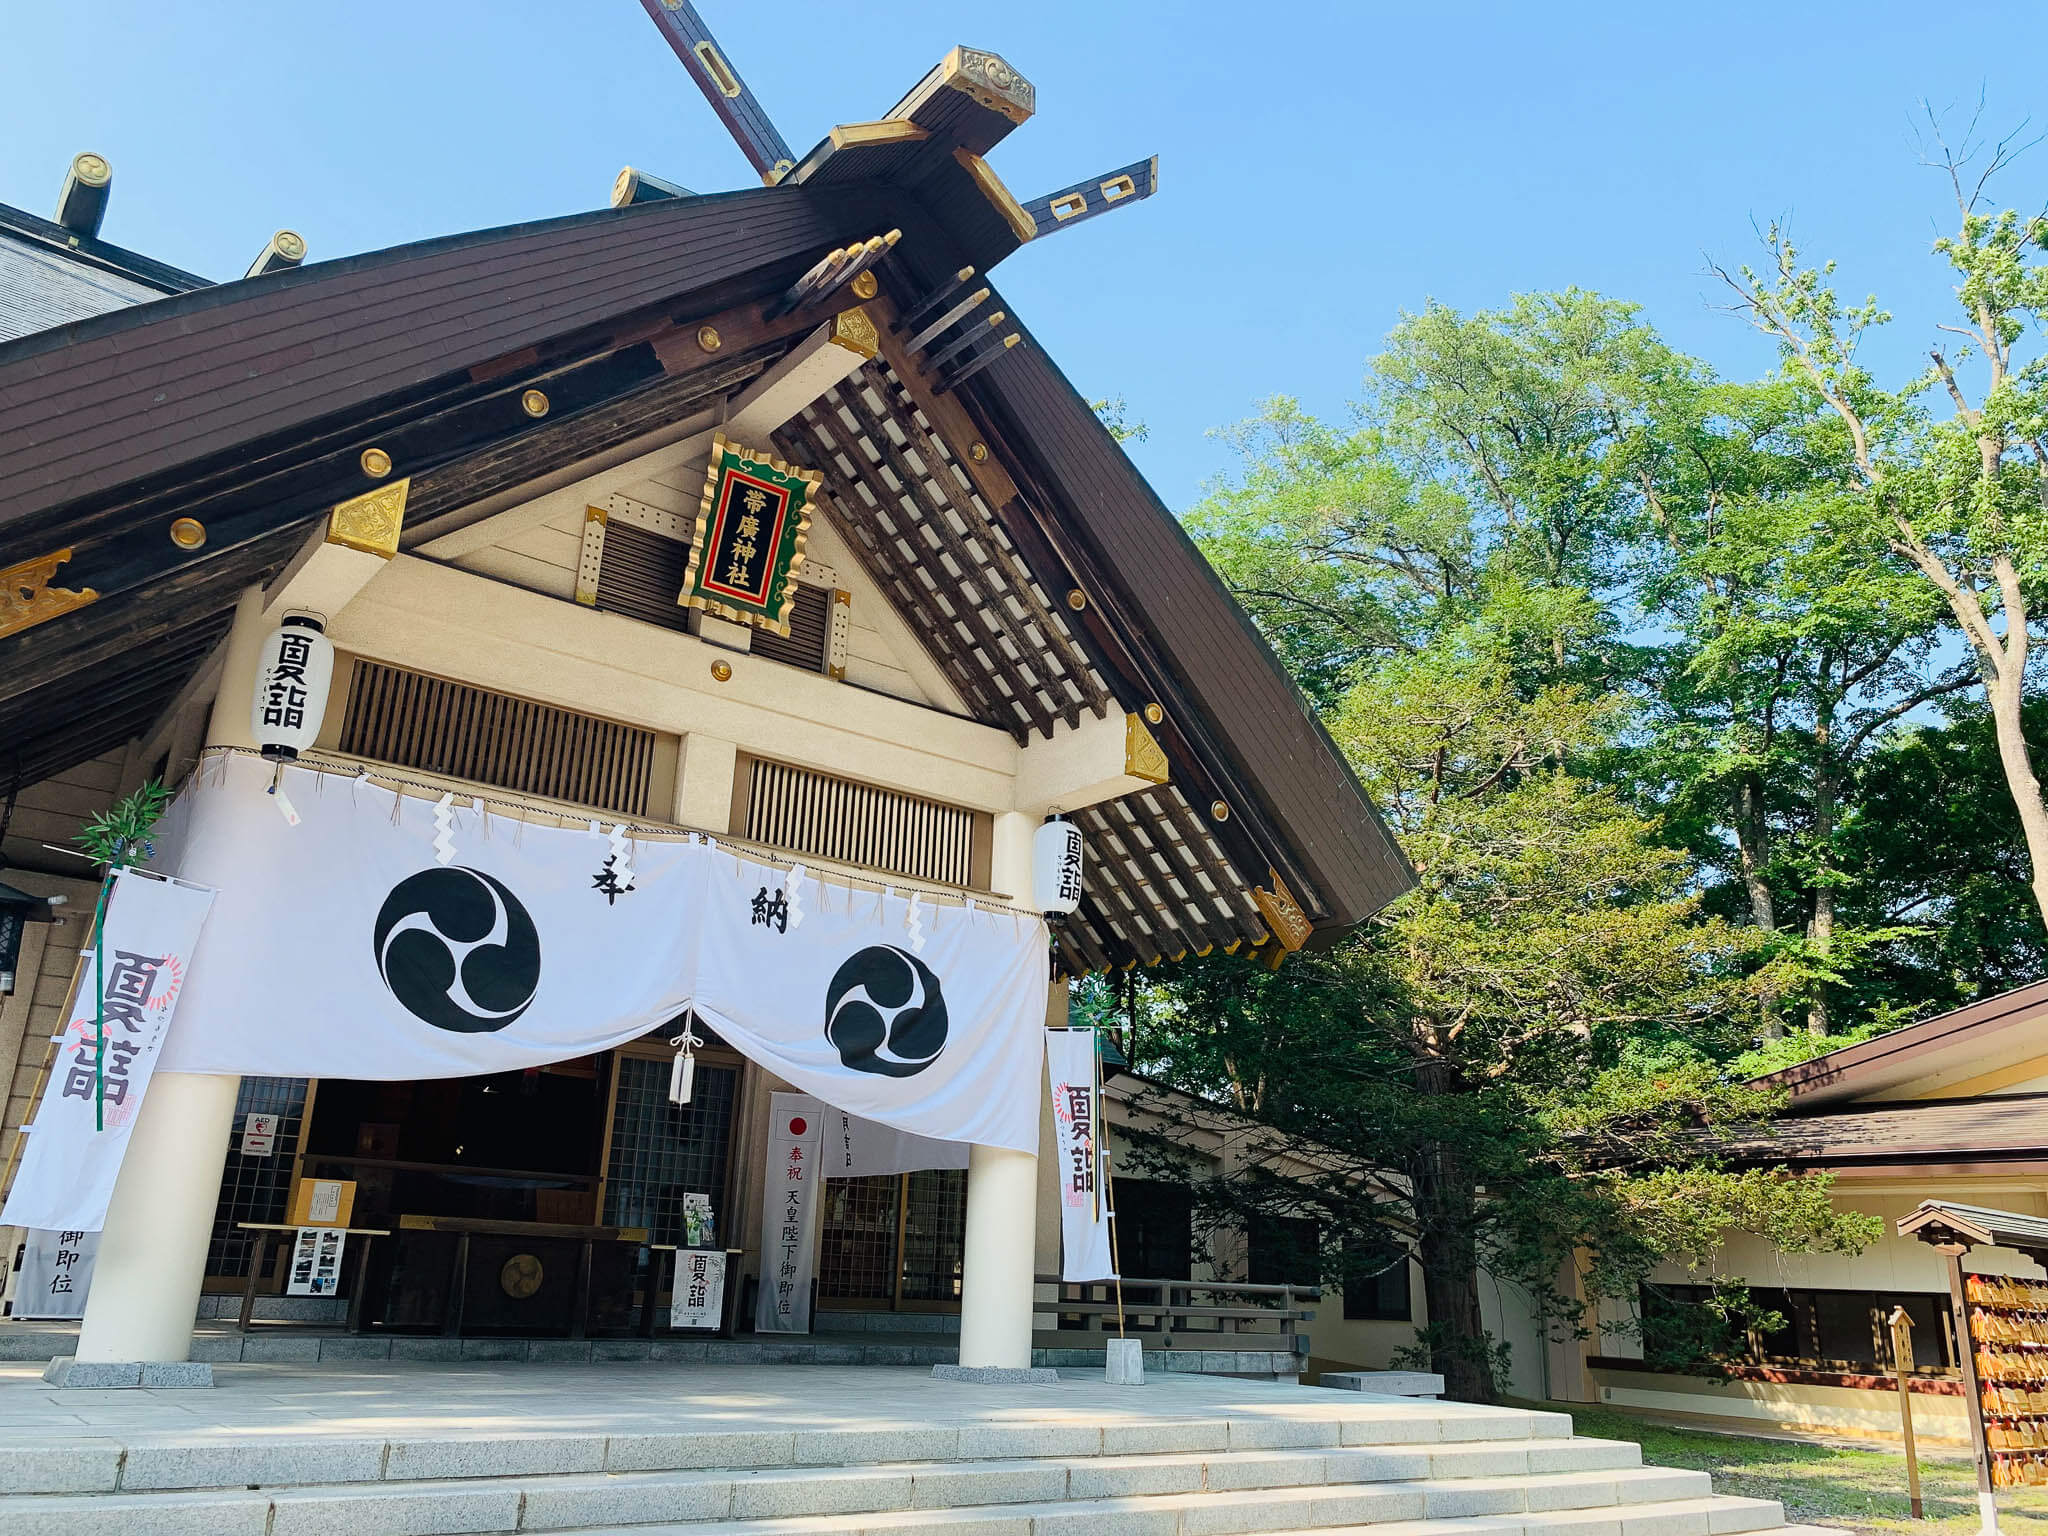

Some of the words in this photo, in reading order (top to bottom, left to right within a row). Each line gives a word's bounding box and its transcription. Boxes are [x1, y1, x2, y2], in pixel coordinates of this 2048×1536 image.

[263, 633, 314, 730] 夏詣
[751, 886, 788, 935] 納
[786, 1146, 804, 1181] 奉祝
[840, 1110, 852, 1168] 月吉日
[1066, 1086, 1094, 1193] 夏詣
[687, 1255, 708, 1308] 夏詣
[776, 1190, 801, 1315] 天皇陛下御即位
